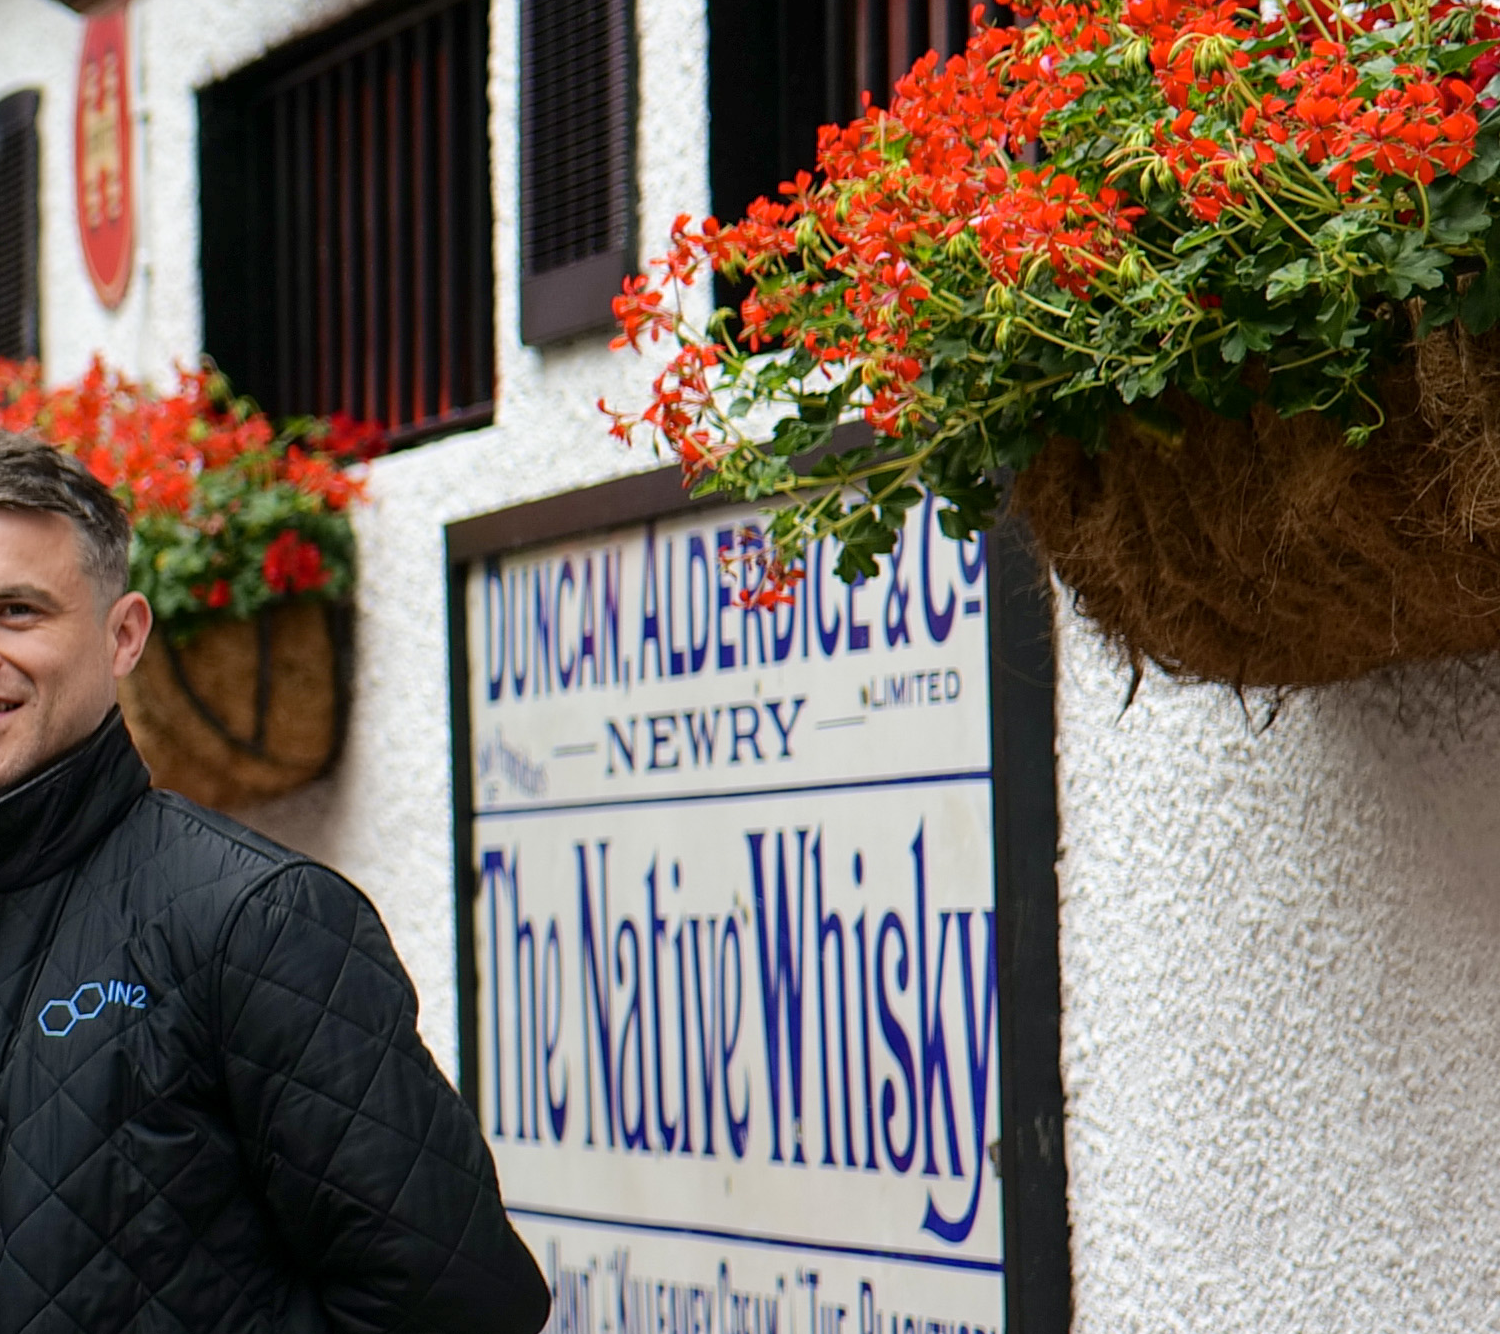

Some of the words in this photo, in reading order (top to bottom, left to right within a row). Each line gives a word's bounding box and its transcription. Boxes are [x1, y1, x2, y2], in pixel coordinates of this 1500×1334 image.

[869, 669, 963, 709] LIMITED
[604, 694, 808, 778] NEWRY
[106, 979, 148, 1010] IN2
[481, 847, 568, 1149] The
[573, 835, 751, 1161] Native
[745, 815, 1000, 1245] Whisky
